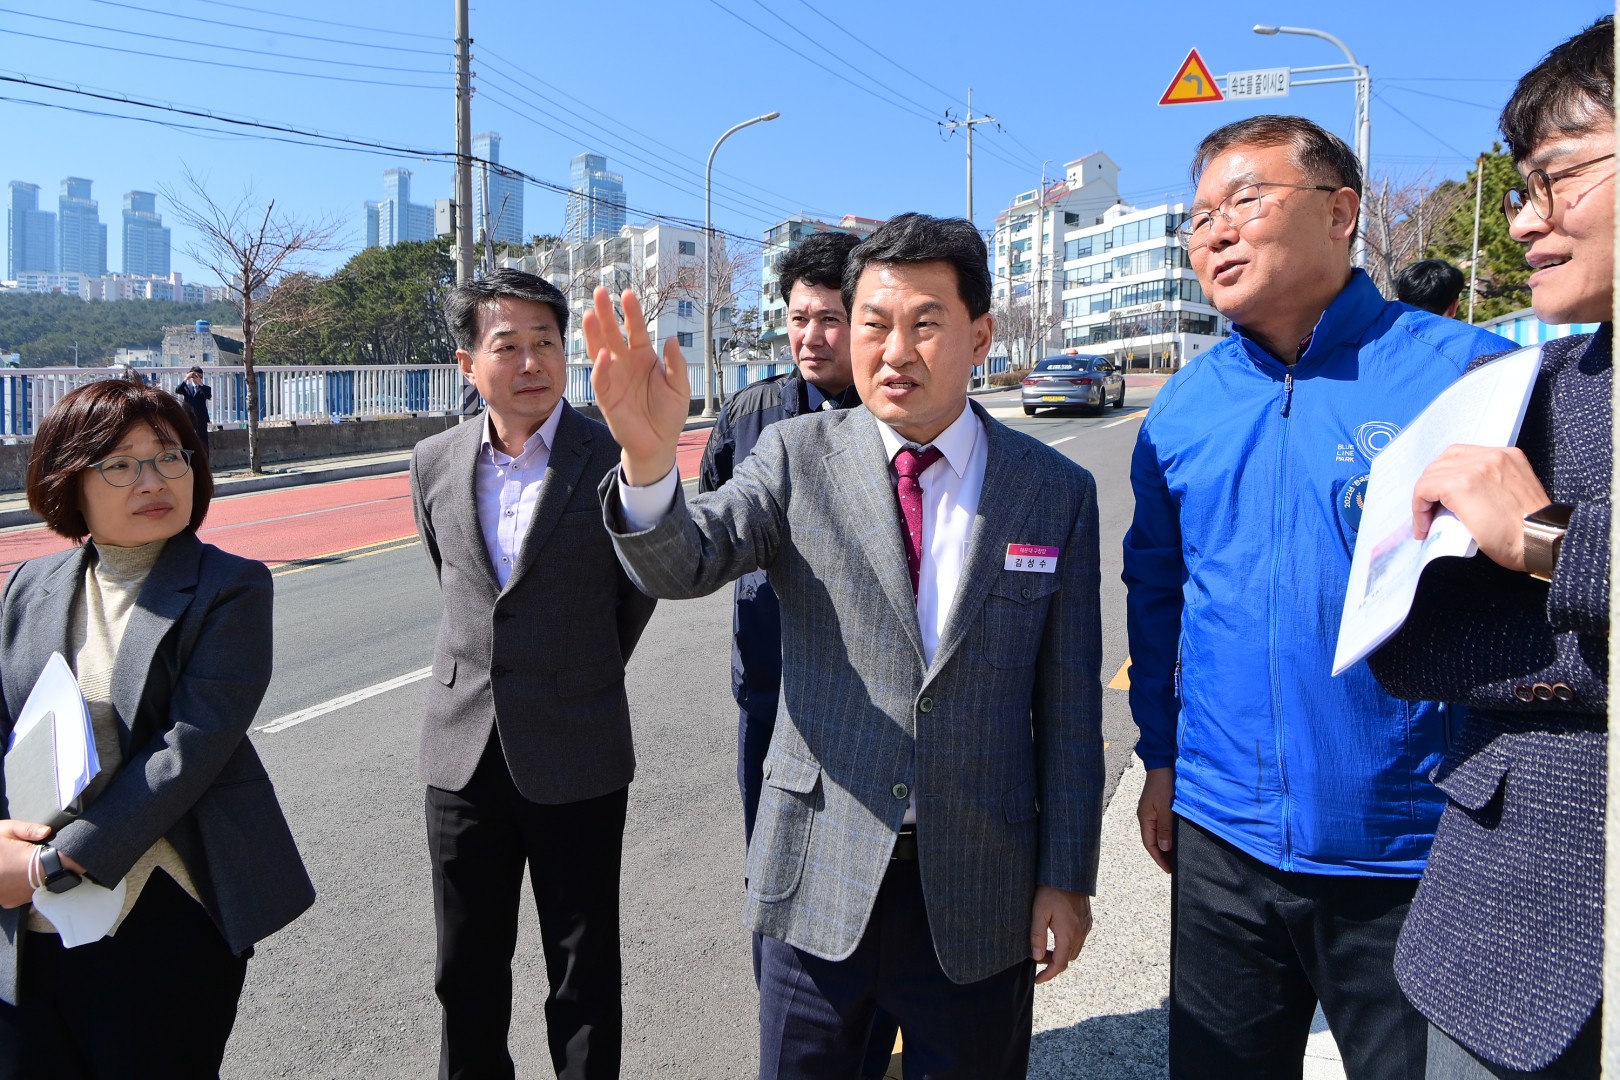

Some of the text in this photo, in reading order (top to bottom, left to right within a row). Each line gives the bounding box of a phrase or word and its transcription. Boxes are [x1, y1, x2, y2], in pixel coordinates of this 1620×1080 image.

[1231, 72, 1285, 96] 속도를 줄이시오
[1343, 485, 1356, 509] 2022년
